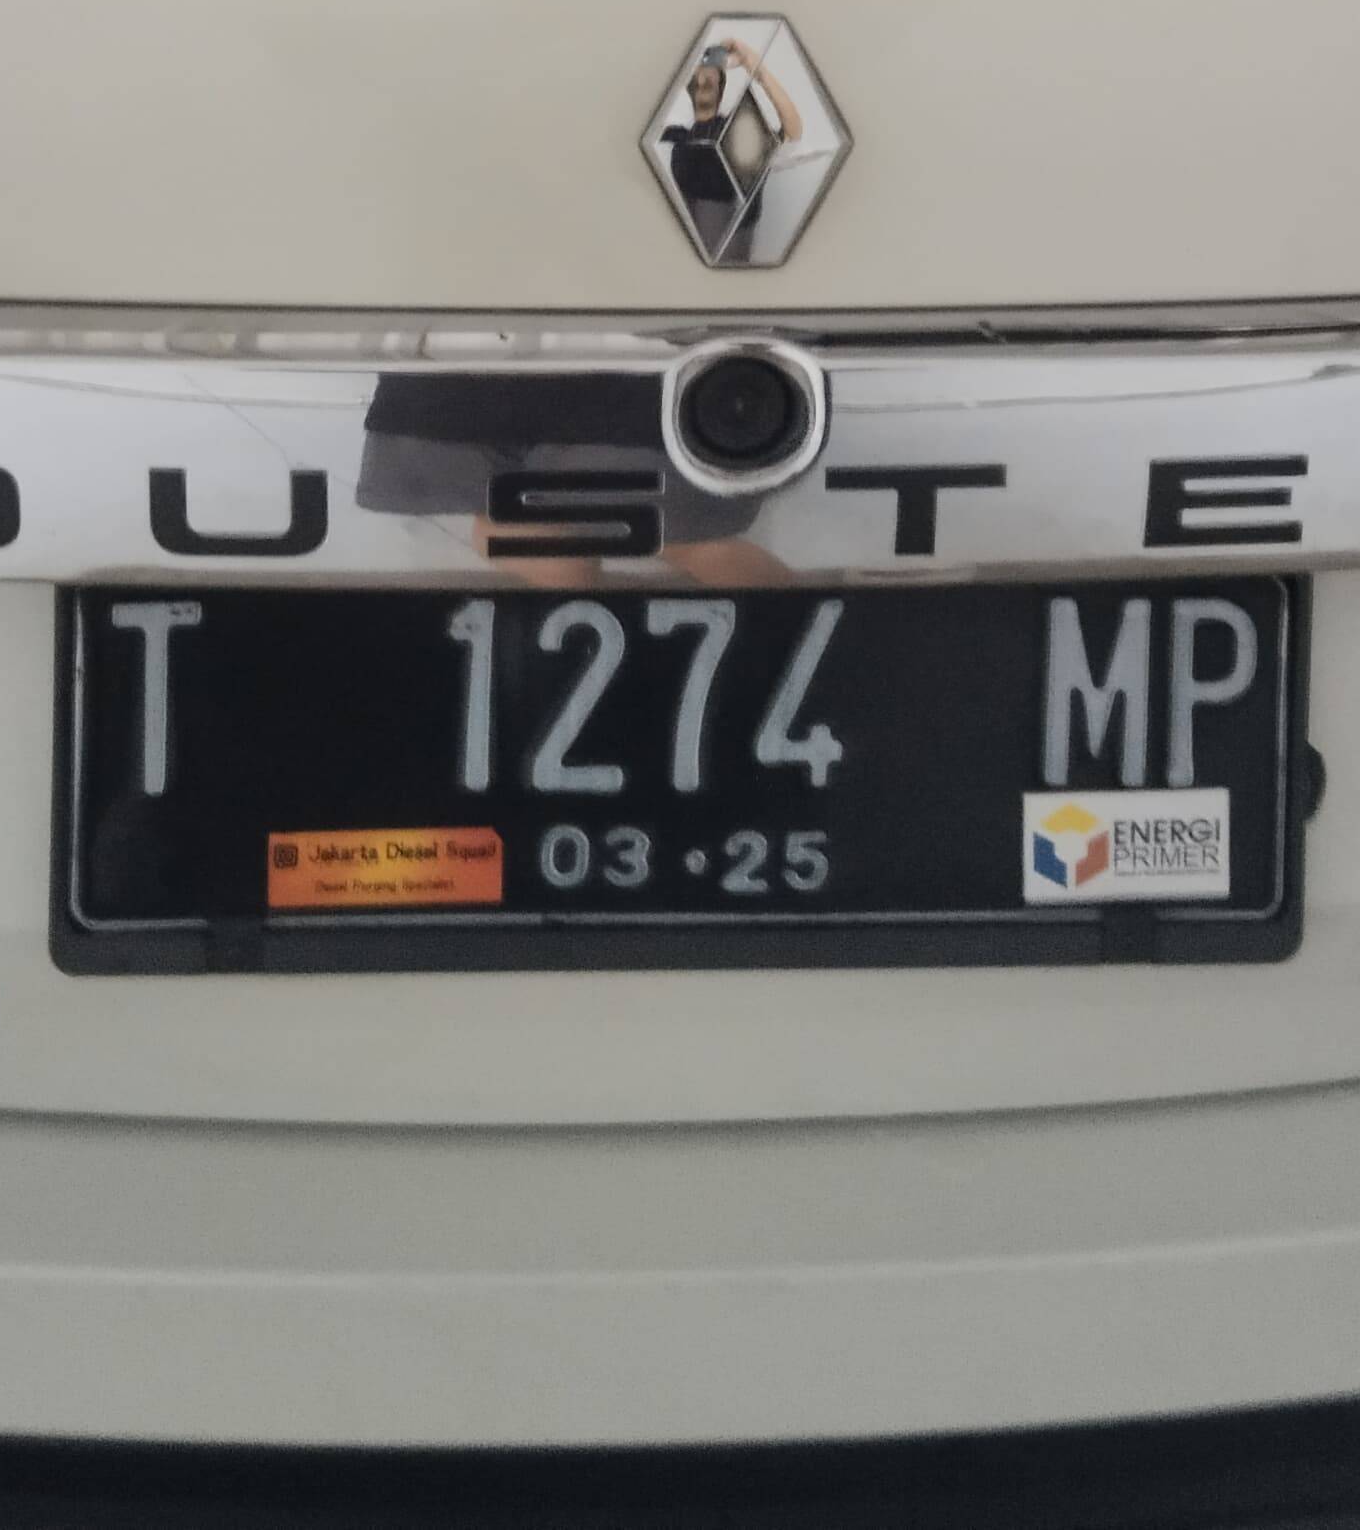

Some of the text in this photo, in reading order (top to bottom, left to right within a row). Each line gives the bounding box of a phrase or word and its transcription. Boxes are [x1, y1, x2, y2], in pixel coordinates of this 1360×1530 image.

[111, 598, 1259, 796] T 1274 MP
[1113, 818, 1221, 845] ENERGI
[308, 840, 497, 864] Jakarta Diesel Squad
[1113, 845, 1220, 869] PRIMER
